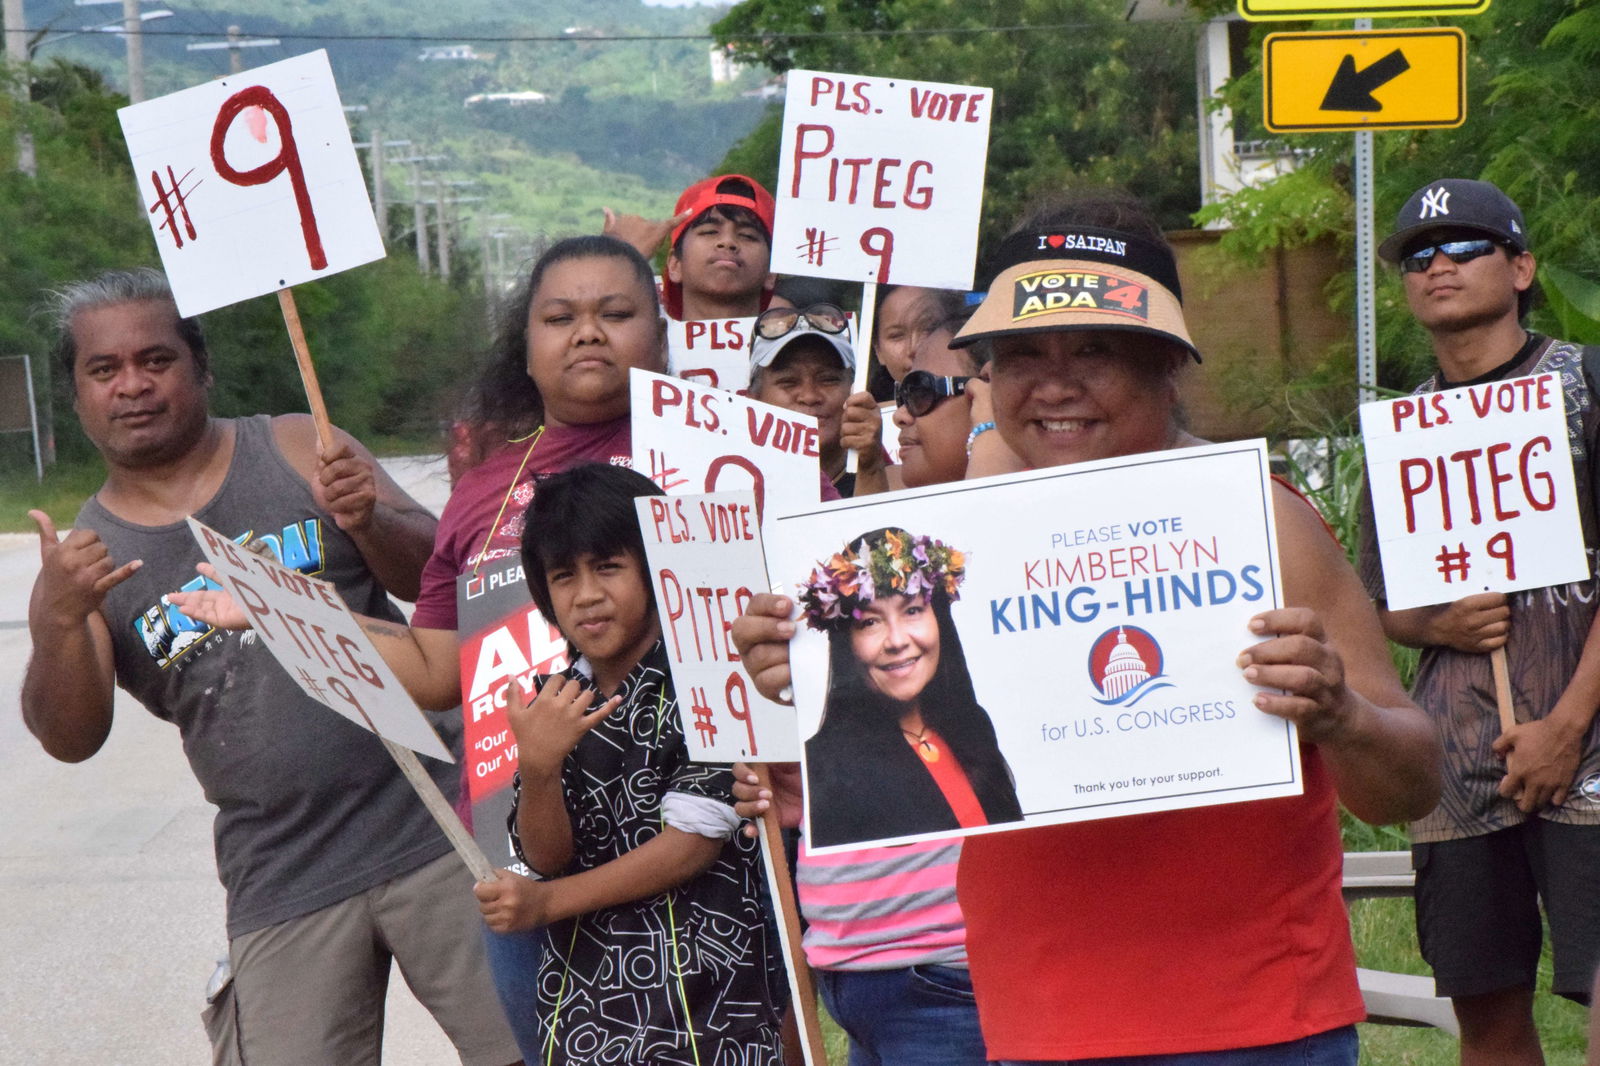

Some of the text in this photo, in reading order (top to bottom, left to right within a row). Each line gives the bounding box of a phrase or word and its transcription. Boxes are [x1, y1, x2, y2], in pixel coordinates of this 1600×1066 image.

[811, 77, 985, 123] PLS. VOTE
[791, 123, 934, 211] PITEG
[1419, 186, 1450, 219] NY
[1064, 234, 1127, 256] SAIPAN
[1019, 273, 1099, 293] VOTE
[1019, 291, 1098, 316] ADA
[651, 379, 728, 435] PLS.
[746, 406, 819, 457] VOTE
[1392, 374, 1553, 432] PLS. VOTE
[1399, 435, 1556, 533] PITEG
[649, 498, 754, 543] PLS. VOTE
[1051, 516, 1183, 549] PLEASE VOTE
[252, 558, 343, 611] VOTE
[489, 565, 527, 590] PLEA
[1024, 535, 1220, 591] KIMBERLYN
[659, 568, 754, 663] PITE
[990, 565, 1265, 635] KING-HINDS
[228, 575, 385, 689] PITEG
[1041, 700, 1236, 742] for U.S. CONGRESS
[476, 744, 519, 777] Our Vi
[1073, 766, 1224, 796] Thank you for your support.
